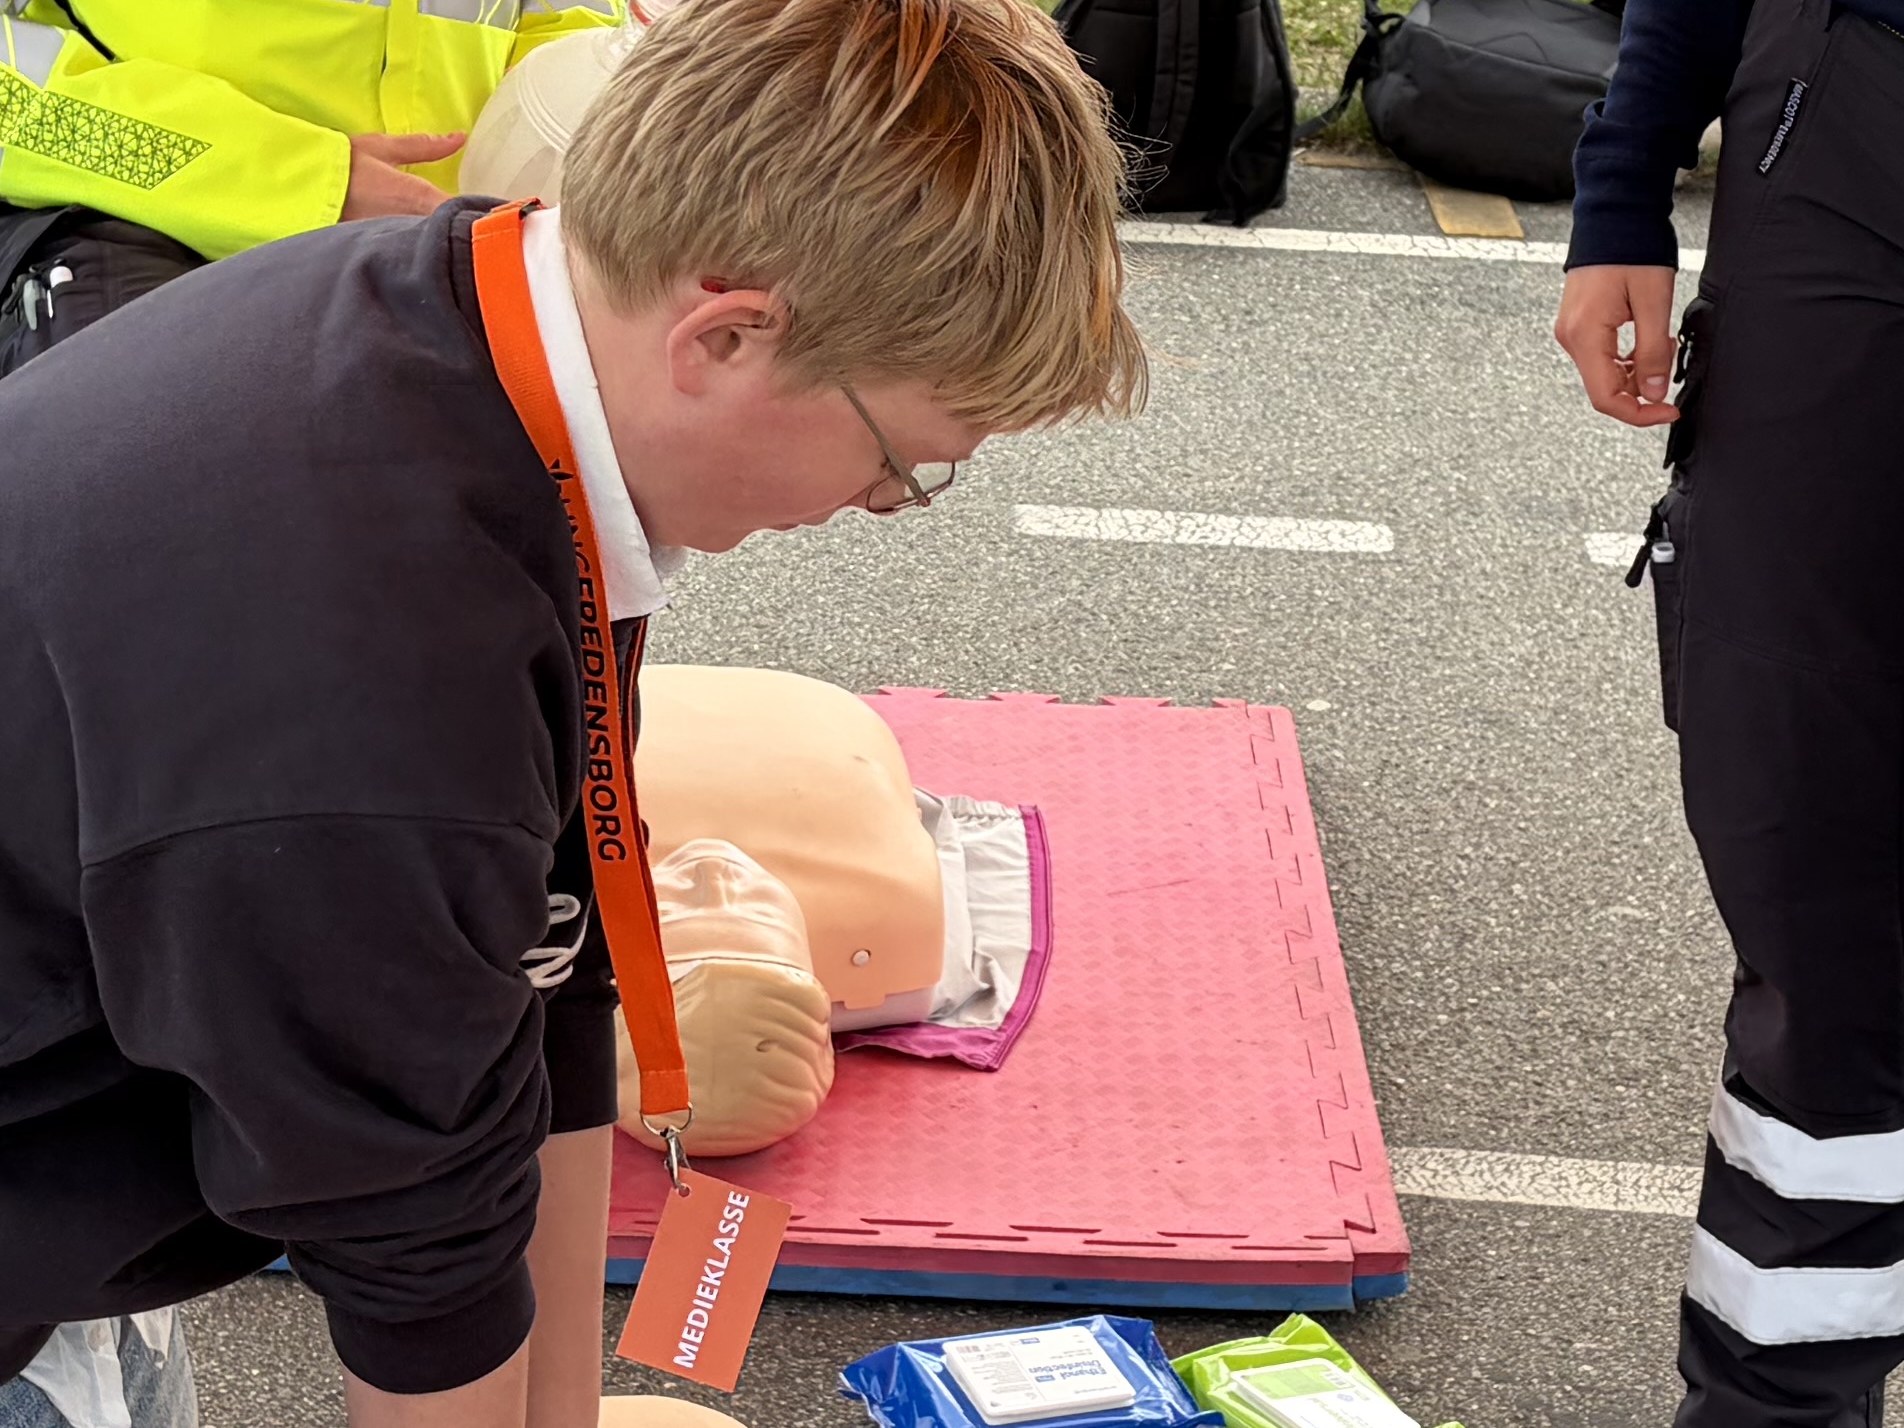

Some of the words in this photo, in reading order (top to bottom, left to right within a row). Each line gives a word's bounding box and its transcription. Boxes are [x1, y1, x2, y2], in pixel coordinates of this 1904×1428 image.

[562, 497, 626, 862] FREDENSBORG
[673, 1190, 750, 1369] MEDIEKLASSE
[1059, 1368, 1107, 1380] Ethanol
